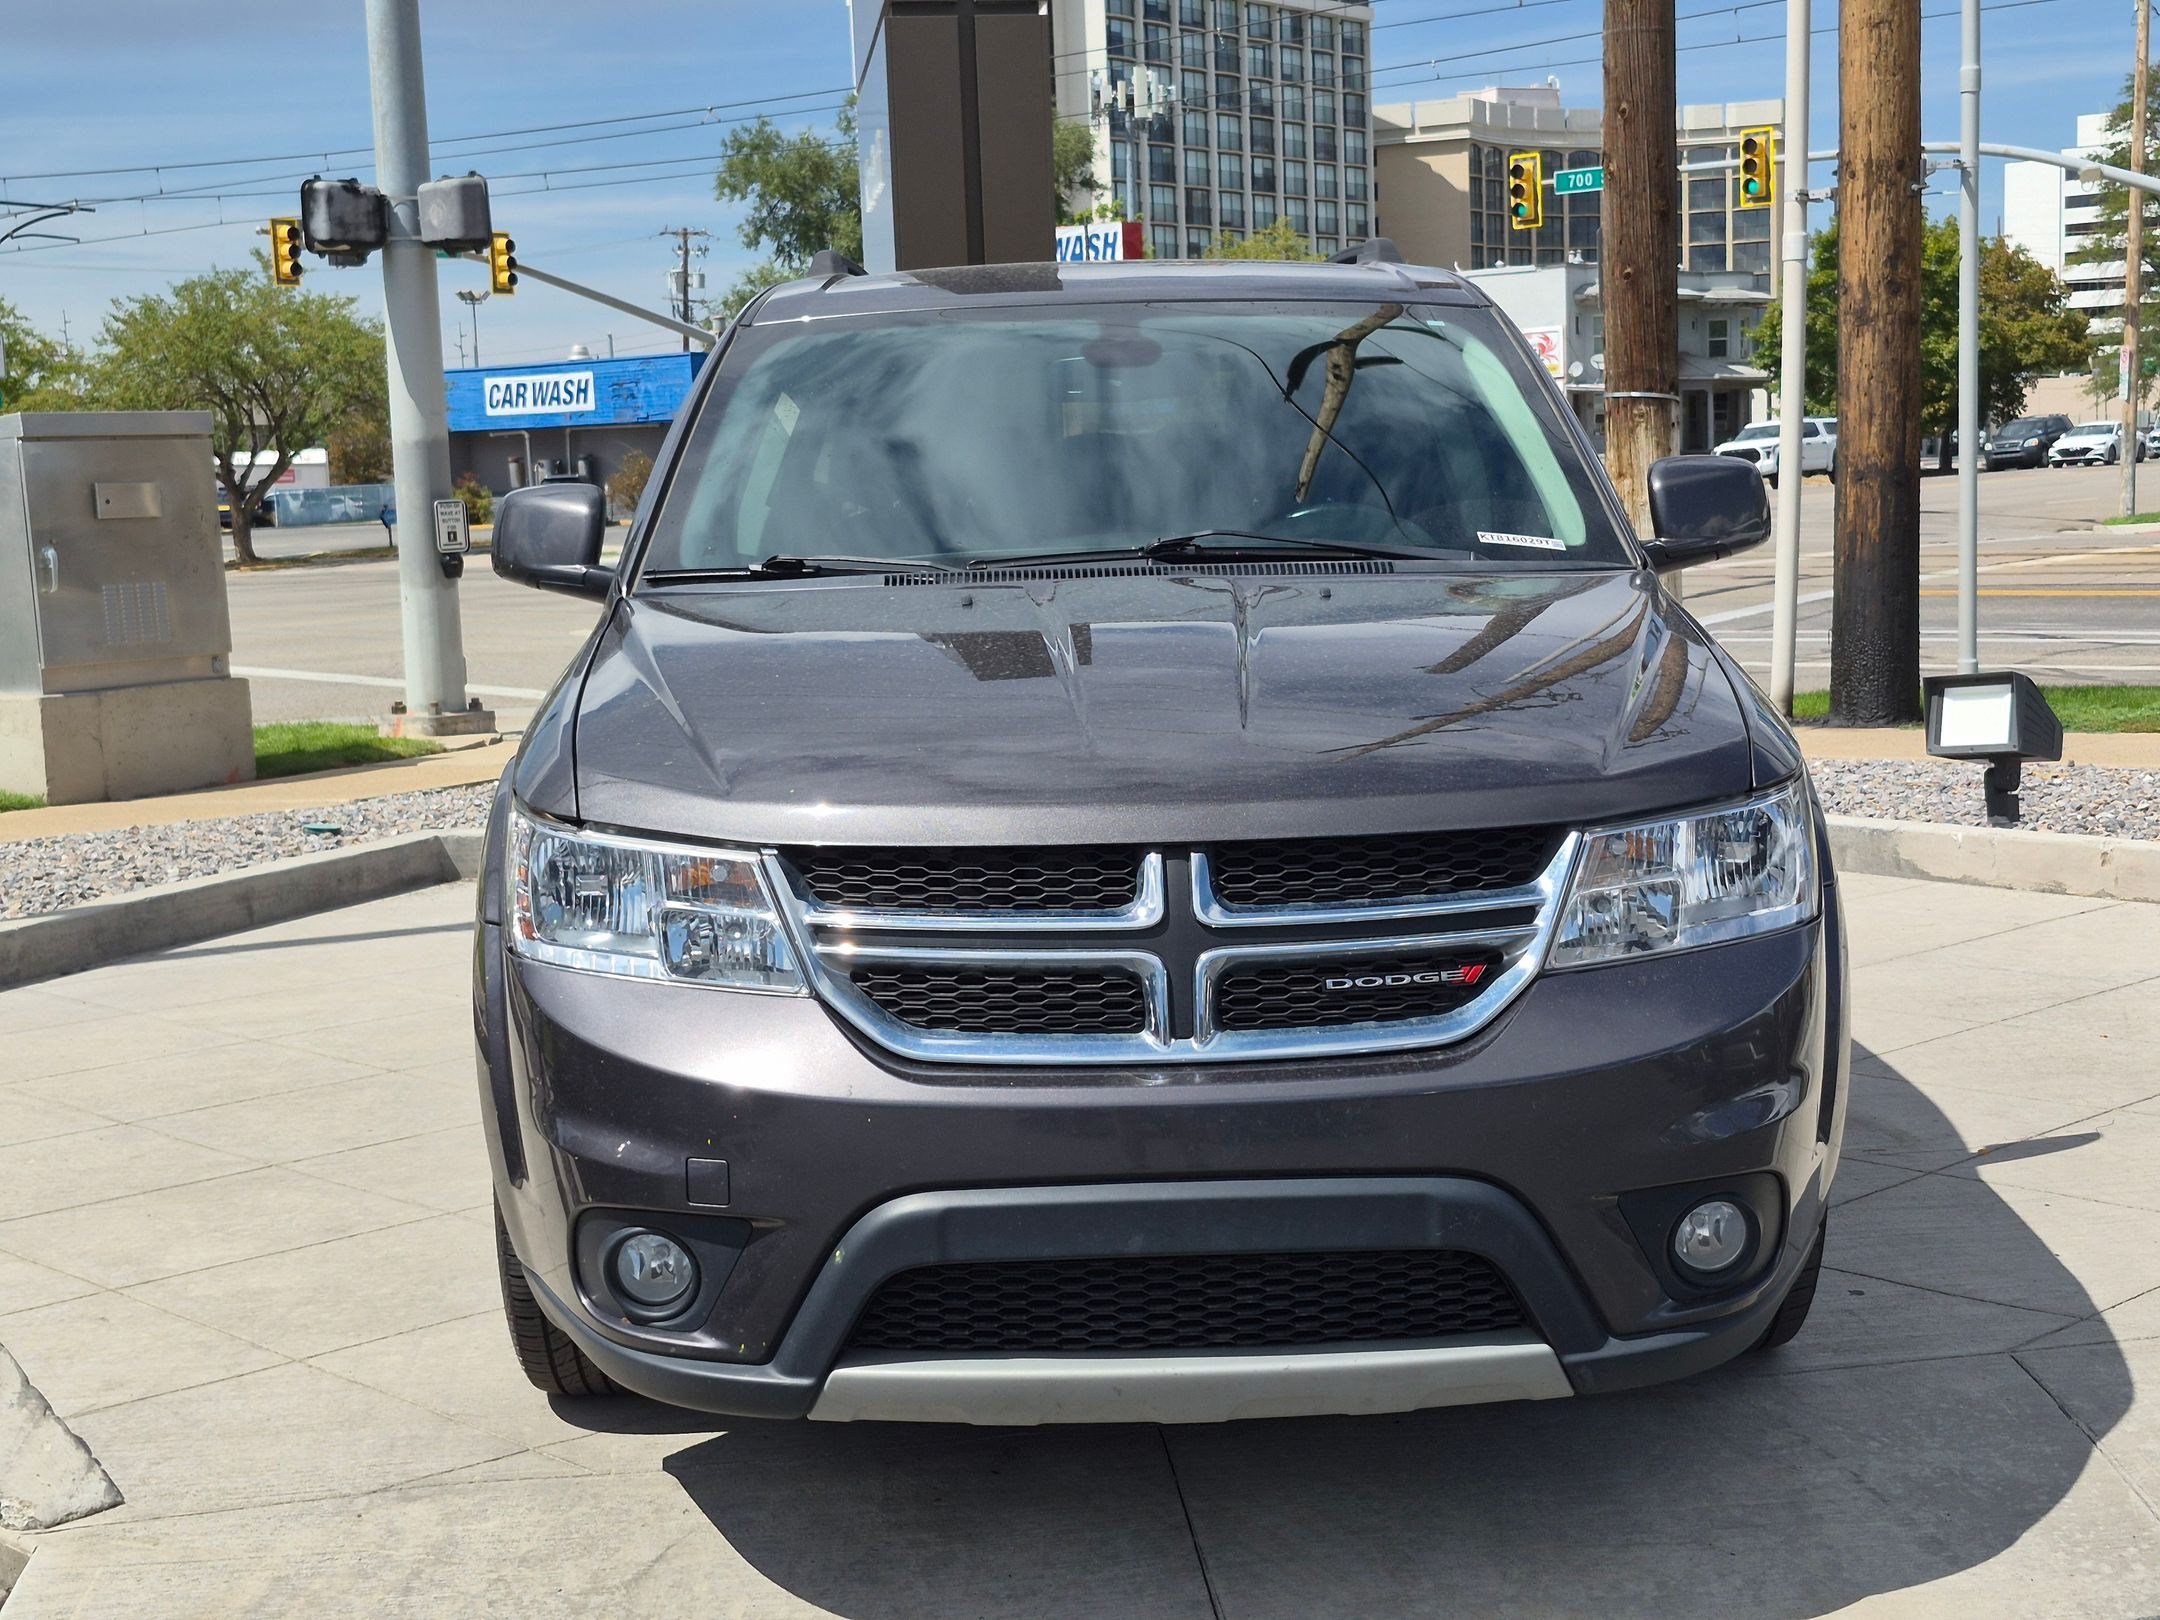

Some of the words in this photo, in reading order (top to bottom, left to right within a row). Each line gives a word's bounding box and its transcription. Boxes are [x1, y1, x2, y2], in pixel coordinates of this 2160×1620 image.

[1568, 173, 1592, 188] 700
[489, 383, 527, 409] CAR
[532, 379, 590, 406] WASH
[1326, 970, 1466, 990] DODGE
